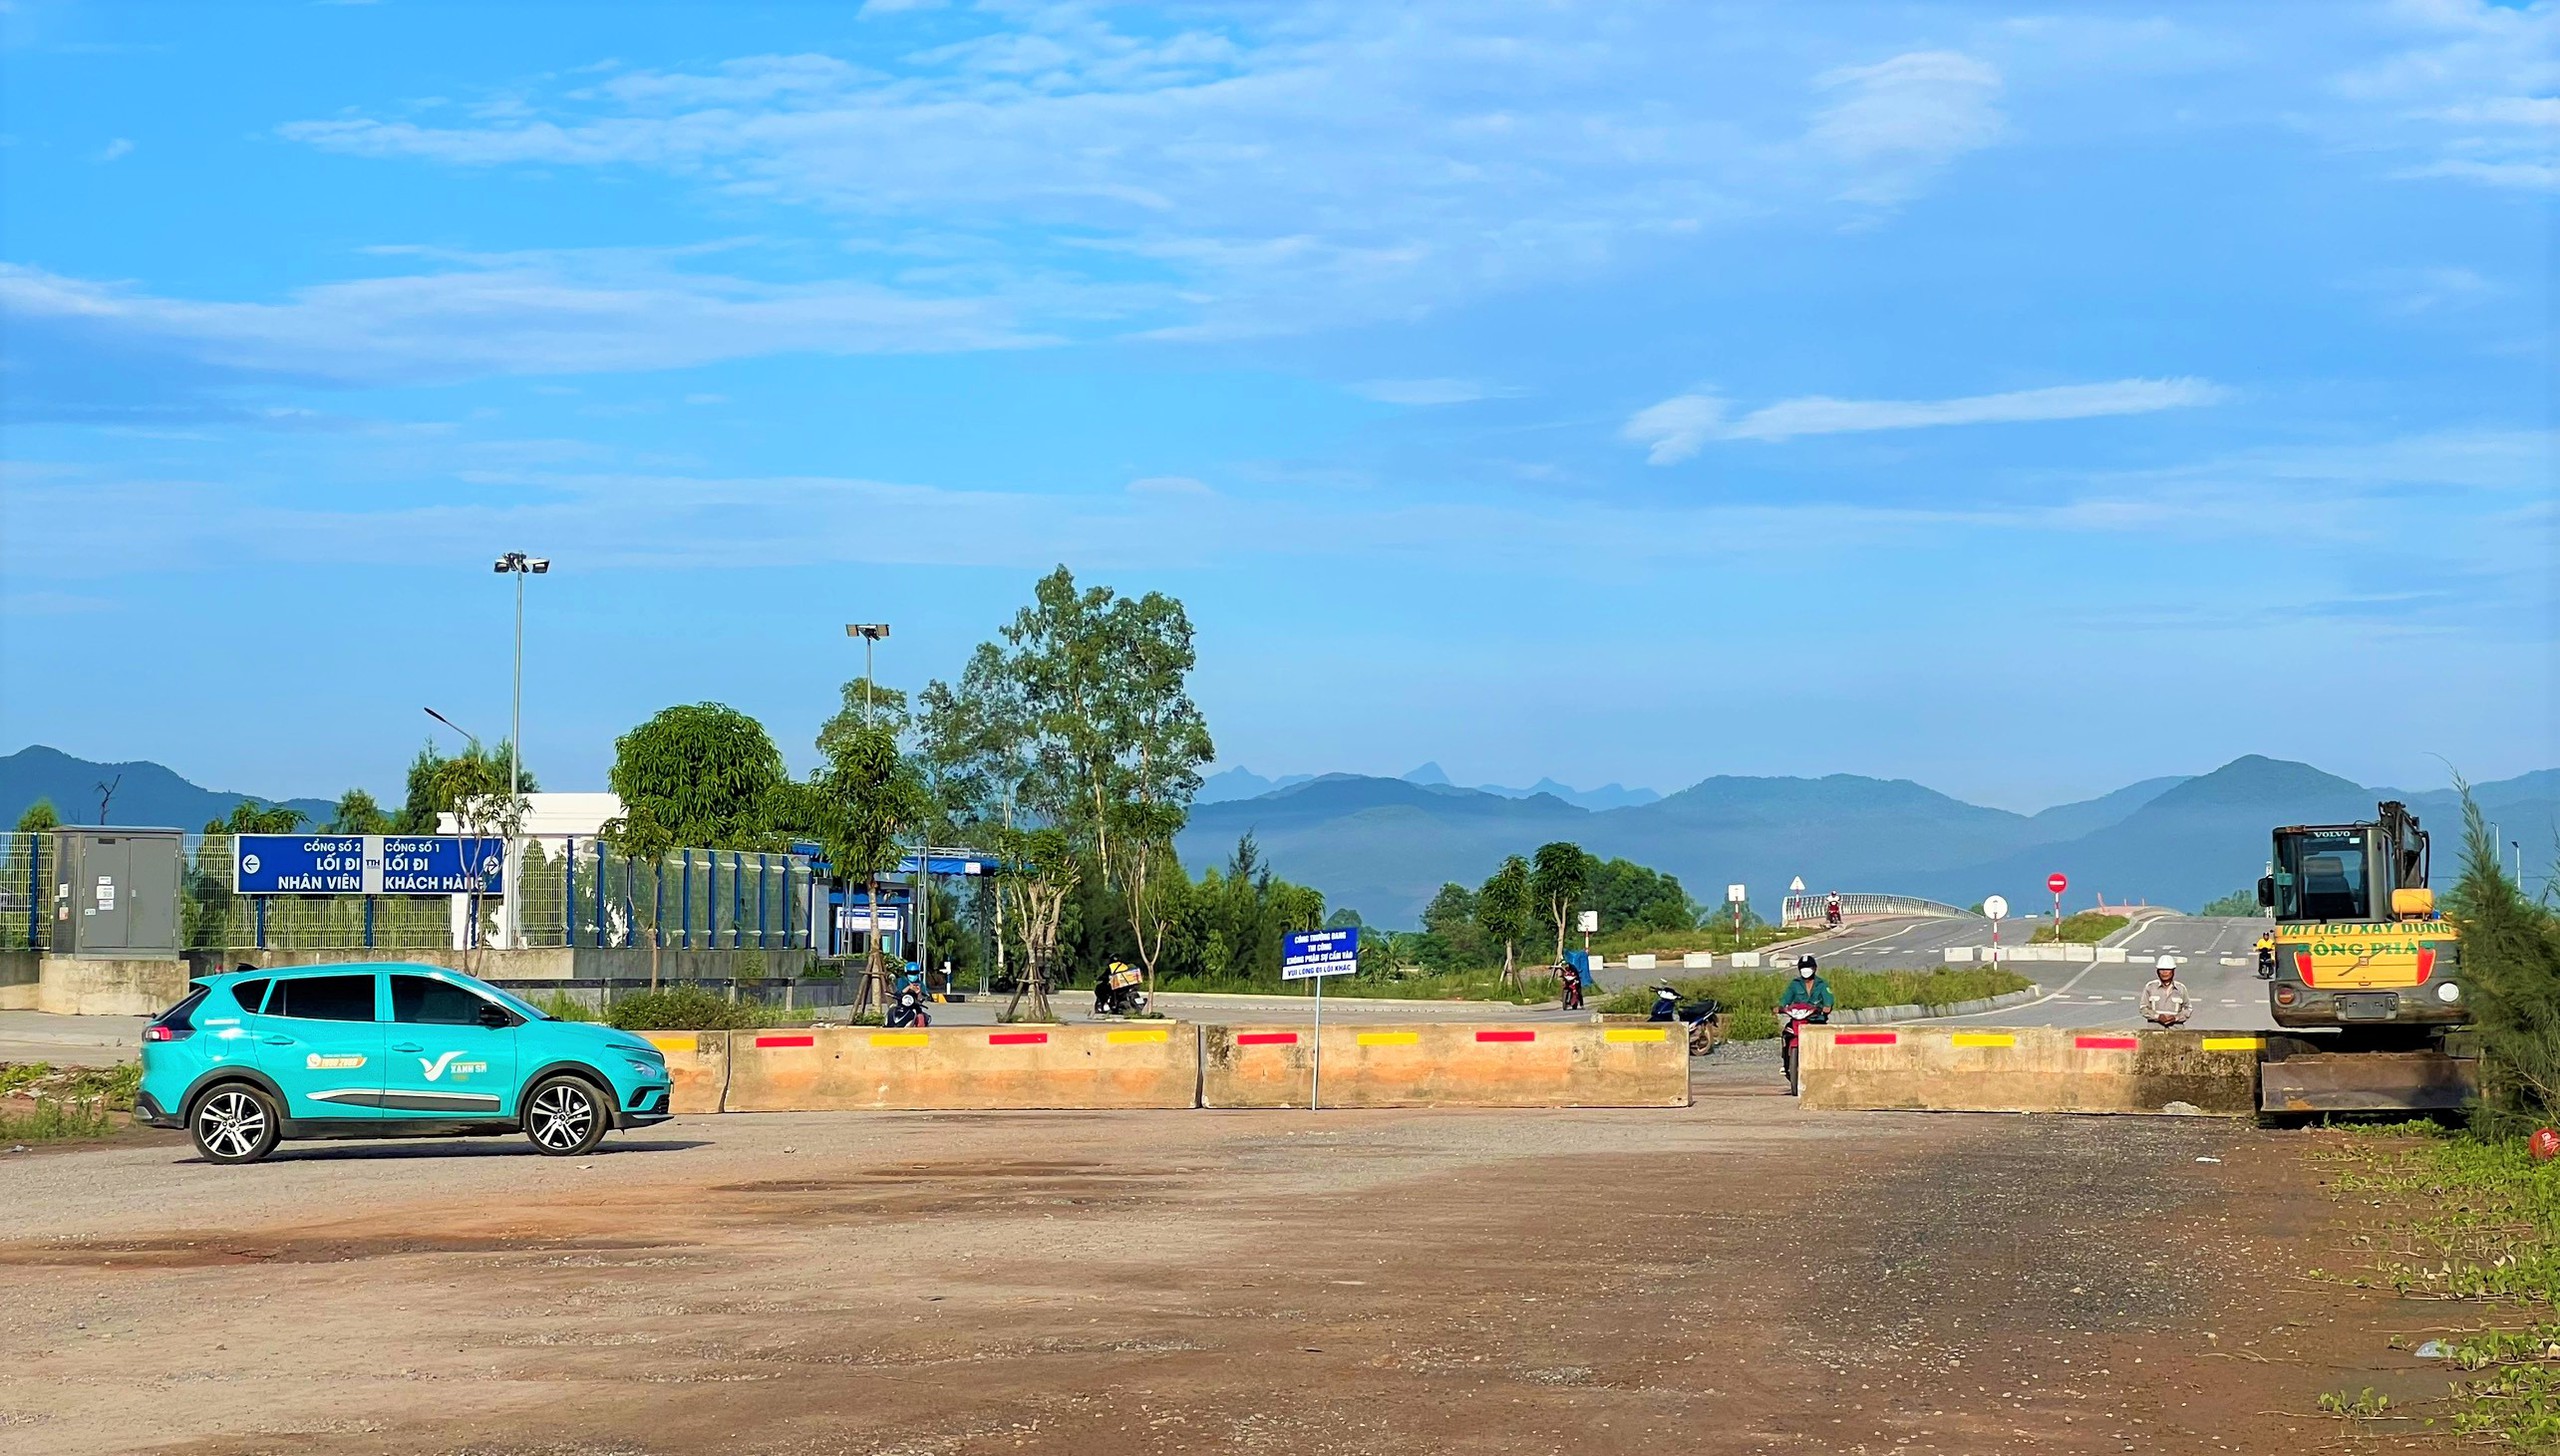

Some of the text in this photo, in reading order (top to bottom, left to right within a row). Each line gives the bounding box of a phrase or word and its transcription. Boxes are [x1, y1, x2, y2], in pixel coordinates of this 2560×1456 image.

[304, 838, 361, 852] CỔNG SỐ 2
[385, 839, 440, 852] CỔNG SỐ 1
[316, 852, 360, 871] LỐI ĐI
[385, 853, 429, 871] LỐI ĐI
[278, 873, 360, 890] NHÂN VIÊN
[385, 873, 438, 890] KHÁCH
